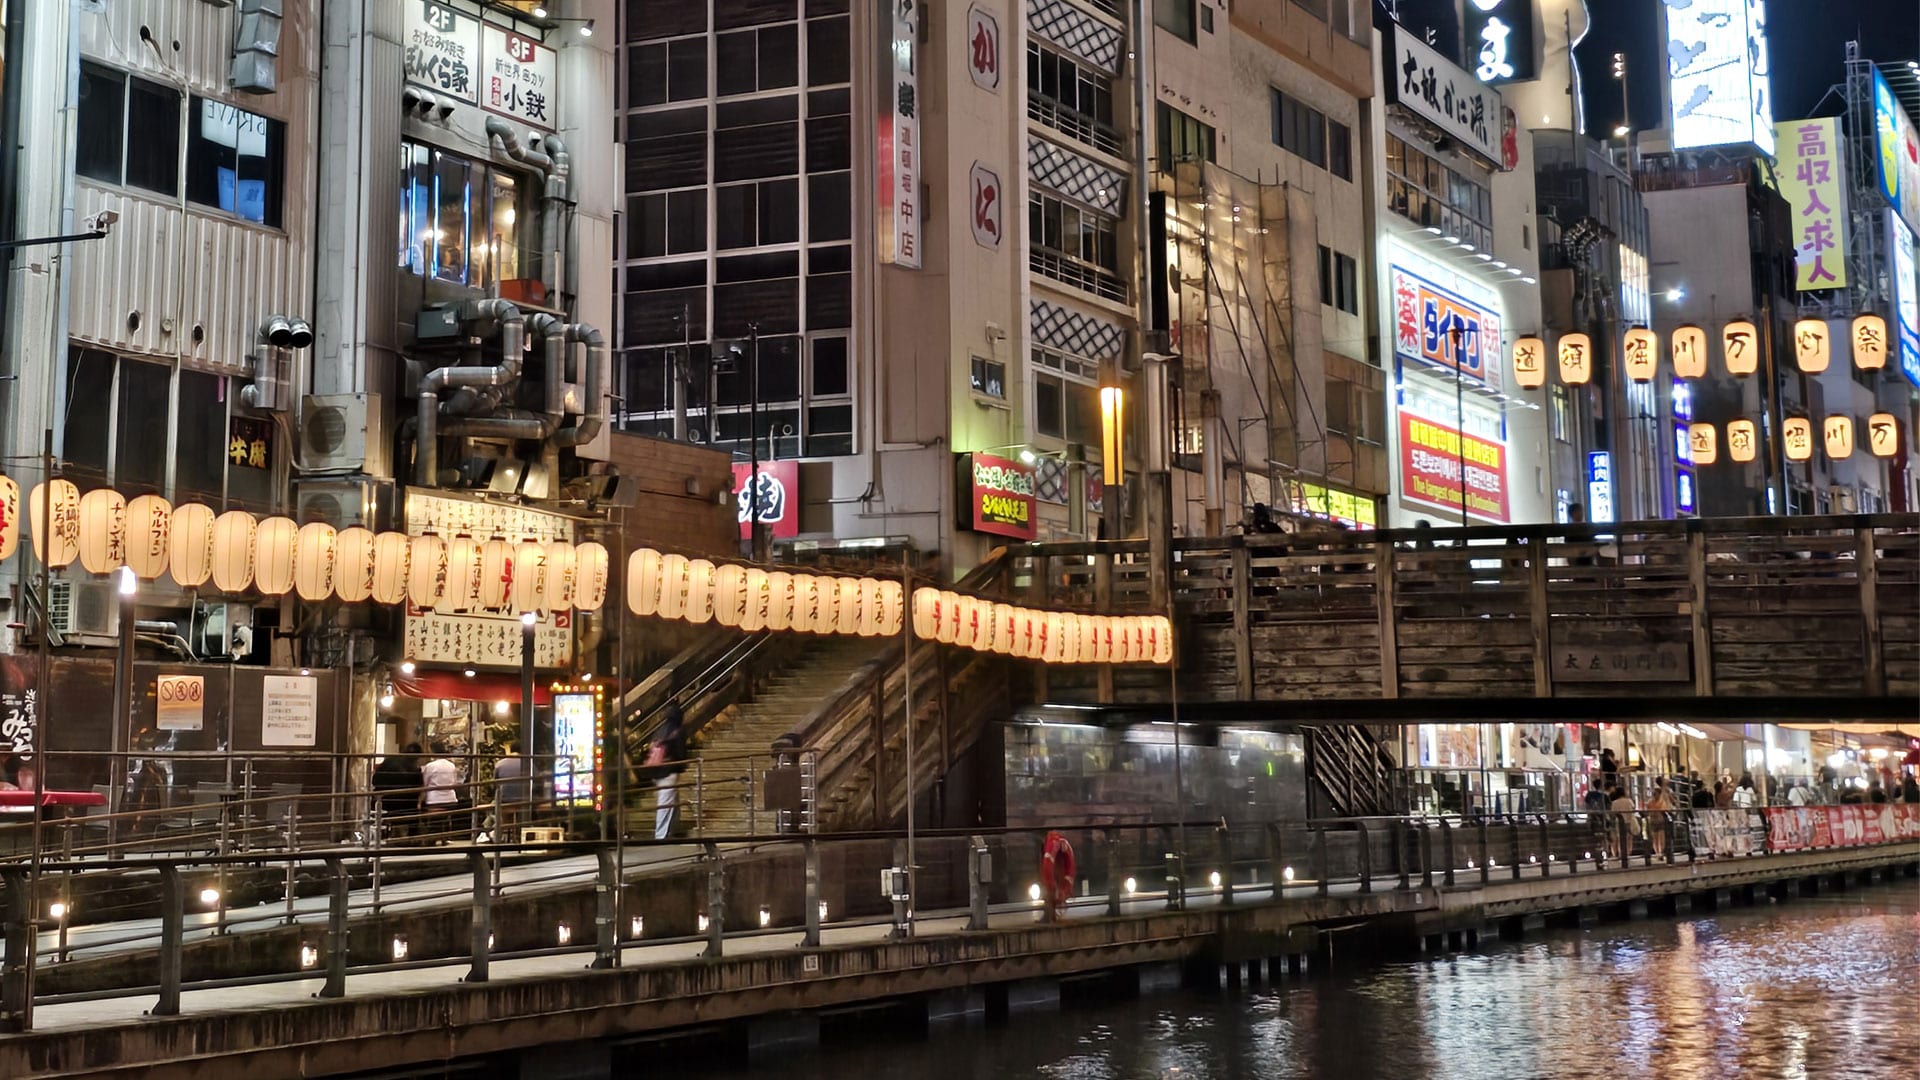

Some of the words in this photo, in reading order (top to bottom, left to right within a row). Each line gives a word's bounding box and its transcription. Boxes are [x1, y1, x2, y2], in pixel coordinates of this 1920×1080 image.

[429, 5, 450, 29] 2F
[412, 29, 465, 60] お好み焼き
[511, 37, 531, 60] 3F
[1797, 124, 1837, 284] 高収入求人
